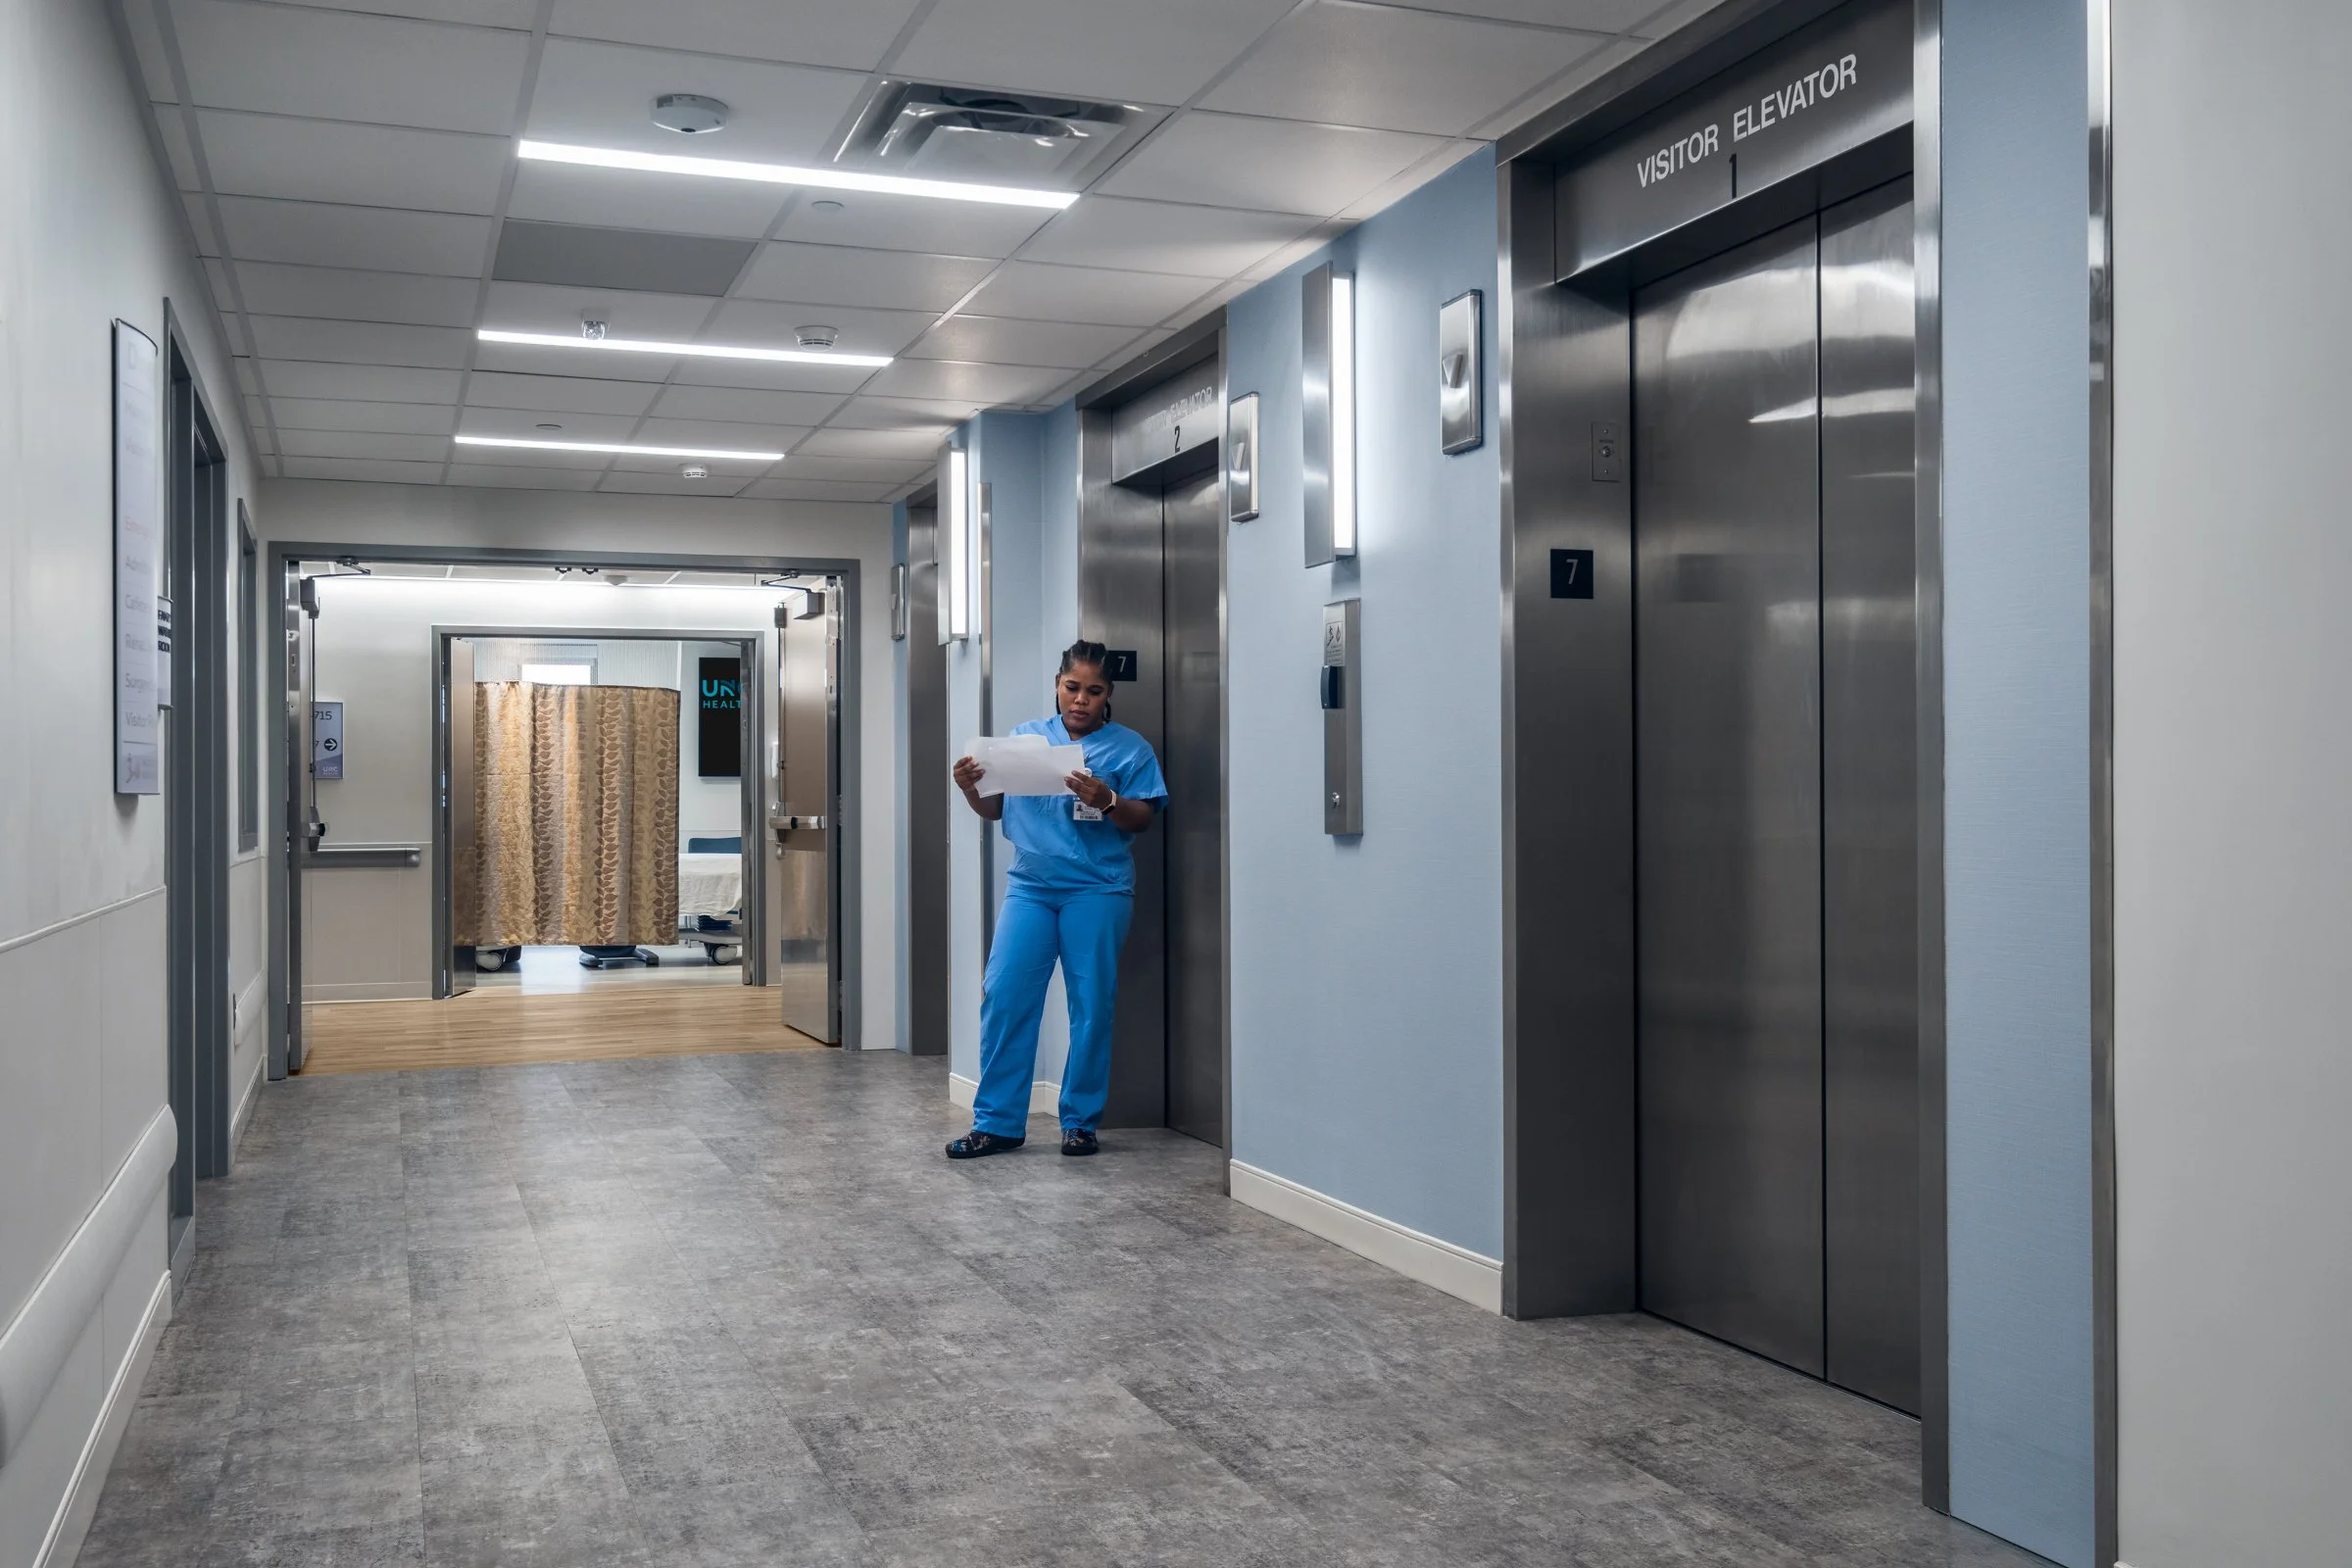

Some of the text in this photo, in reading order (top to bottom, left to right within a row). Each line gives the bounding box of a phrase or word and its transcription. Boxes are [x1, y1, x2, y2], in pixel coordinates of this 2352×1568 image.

[1637, 53, 1857, 188] VISITOR ELEVATOR
[1729, 153, 1738, 199] 1
[1174, 424, 1181, 454] 2
[1566, 559, 1579, 585] 7
[1117, 656, 1127, 673] 7
[702, 679, 742, 697] UN
